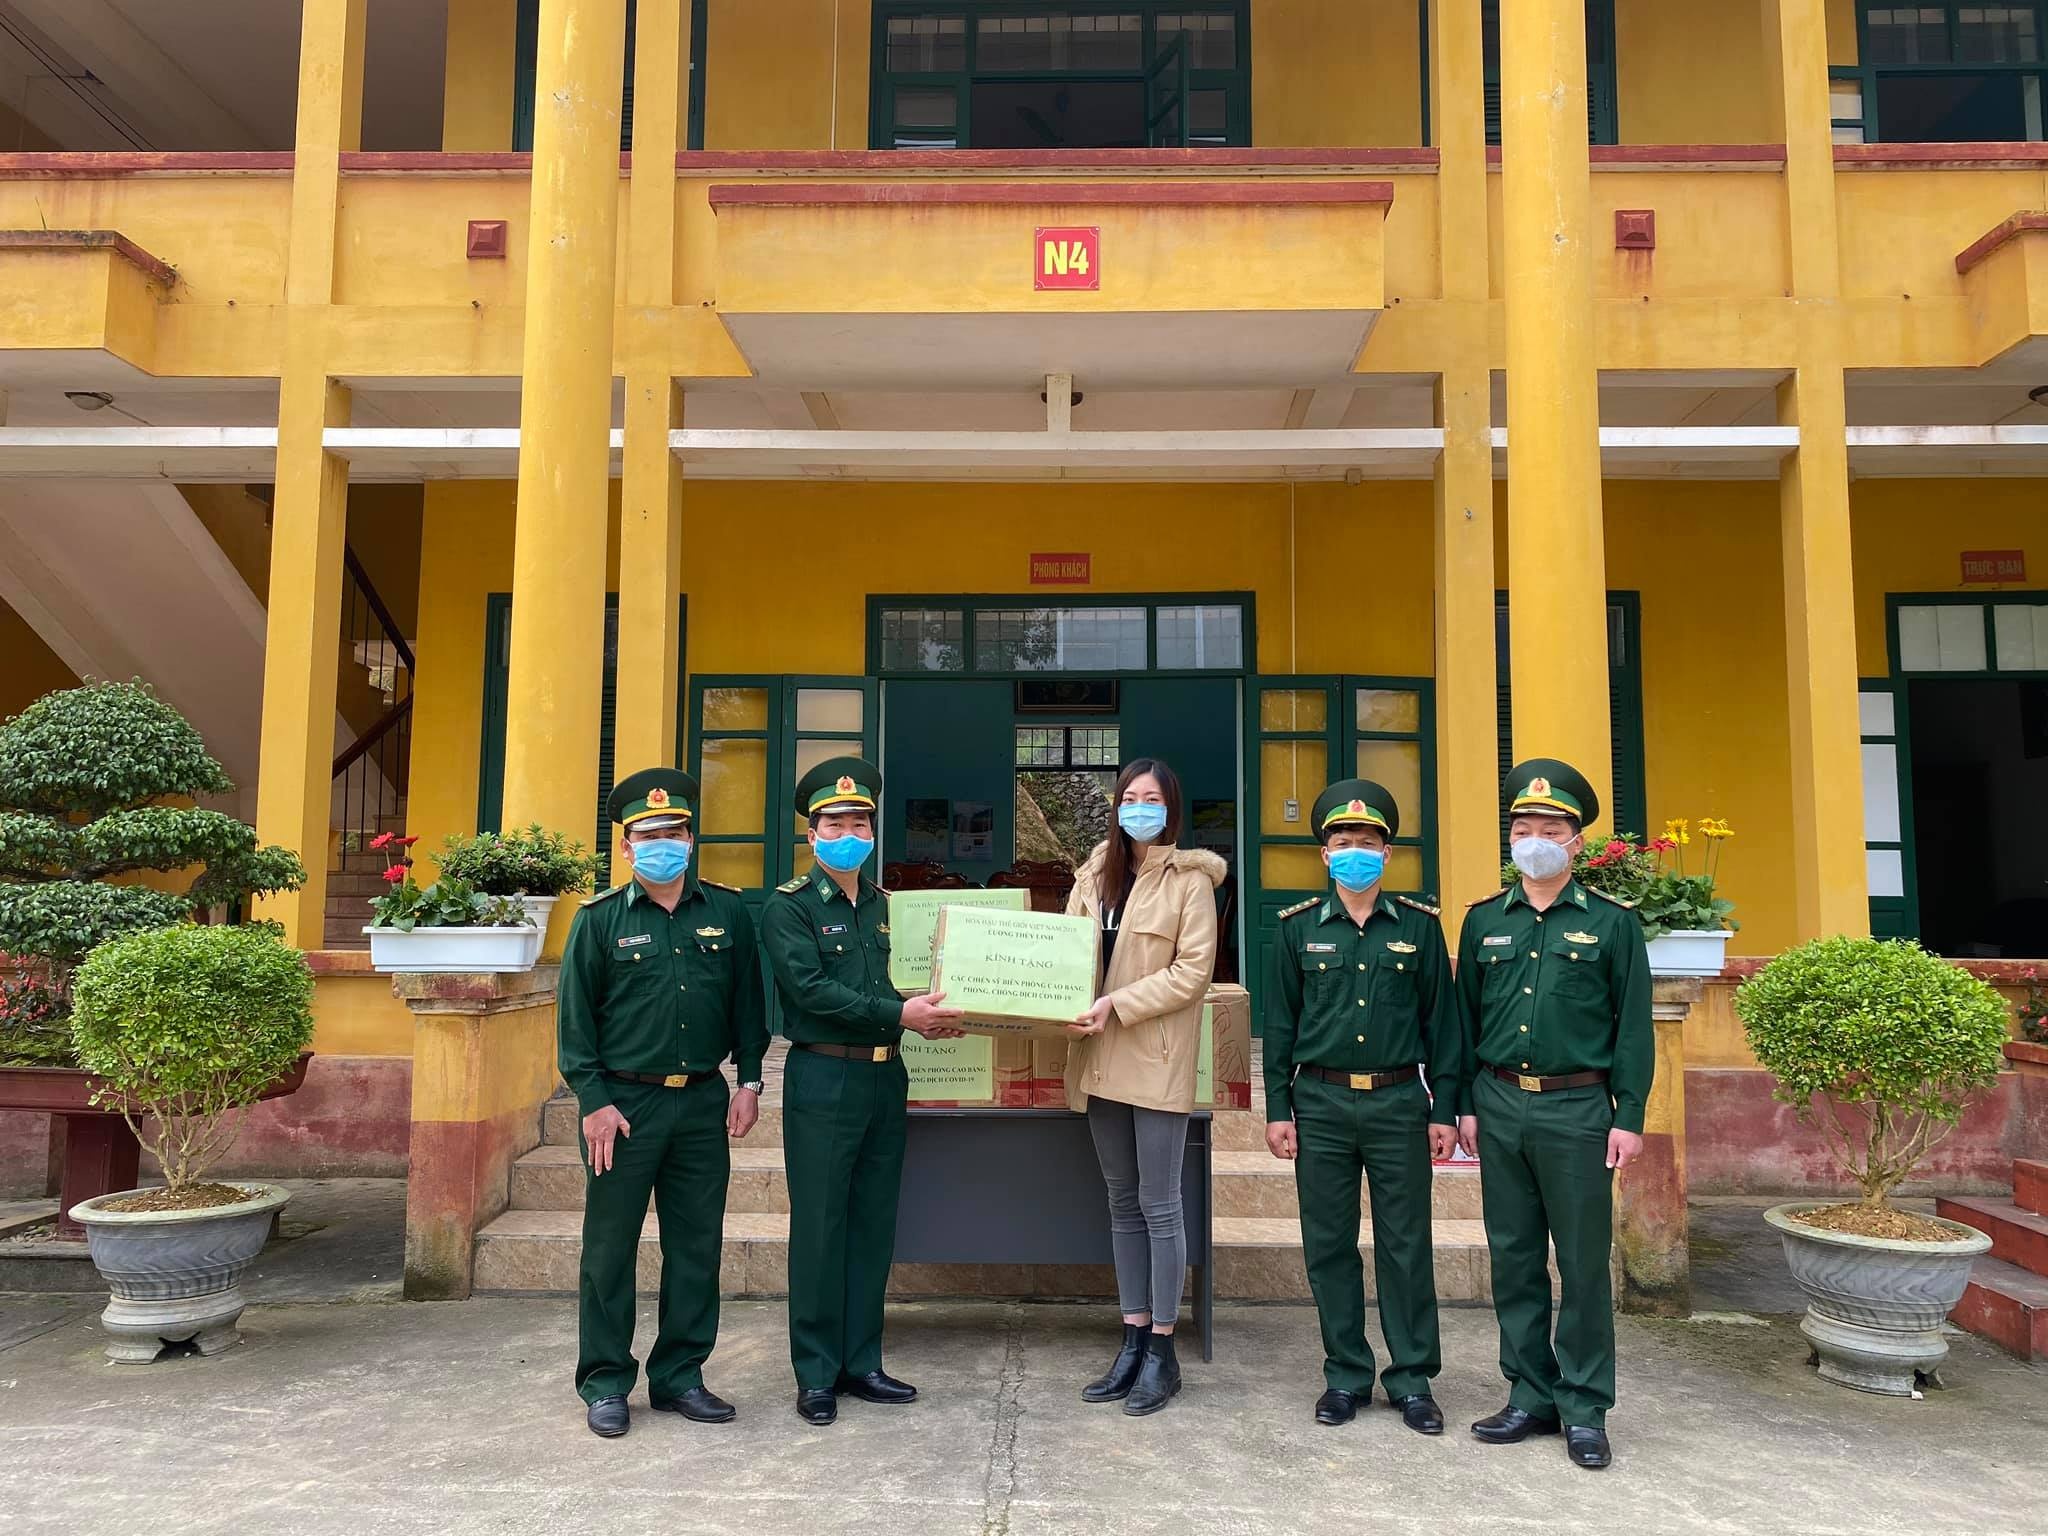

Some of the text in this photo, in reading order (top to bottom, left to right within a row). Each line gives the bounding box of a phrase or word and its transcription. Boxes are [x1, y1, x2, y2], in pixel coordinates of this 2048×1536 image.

[1044, 240, 1089, 275] N4
[1033, 559, 1087, 578] PHÒNG KHÁCH
[1998, 560, 2023, 576] BAN
[965, 917, 980, 925] HOA
[982, 918, 996, 927] HẬU
[999, 918, 1011, 928] THẾ
[1012, 920, 1028, 929] GIỚI
[1029, 922, 1045, 931] VIỆT
[1046, 924, 1062, 932] NAM
[1036, 933, 1054, 942] LINH
[985, 952, 1054, 969] KÍNH TẶNG
[950, 974, 967, 983] CÁC
[967, 974, 991, 984] CHIẾN
[1021, 979, 1046, 989] PHÒNG
[1047, 982, 1064, 991] CAO
[1019, 990, 1038, 999] DỊCH
[1039, 991, 1072, 1001] COVID-19
[910, 1065, 926, 1074] BIÊN
[928, 1065, 951, 1074] PHÒNG
[952, 1066, 967, 1074] CAO
[926, 1076, 944, 1085] DỊCH
[944, 1076, 975, 1084] COVID-19
